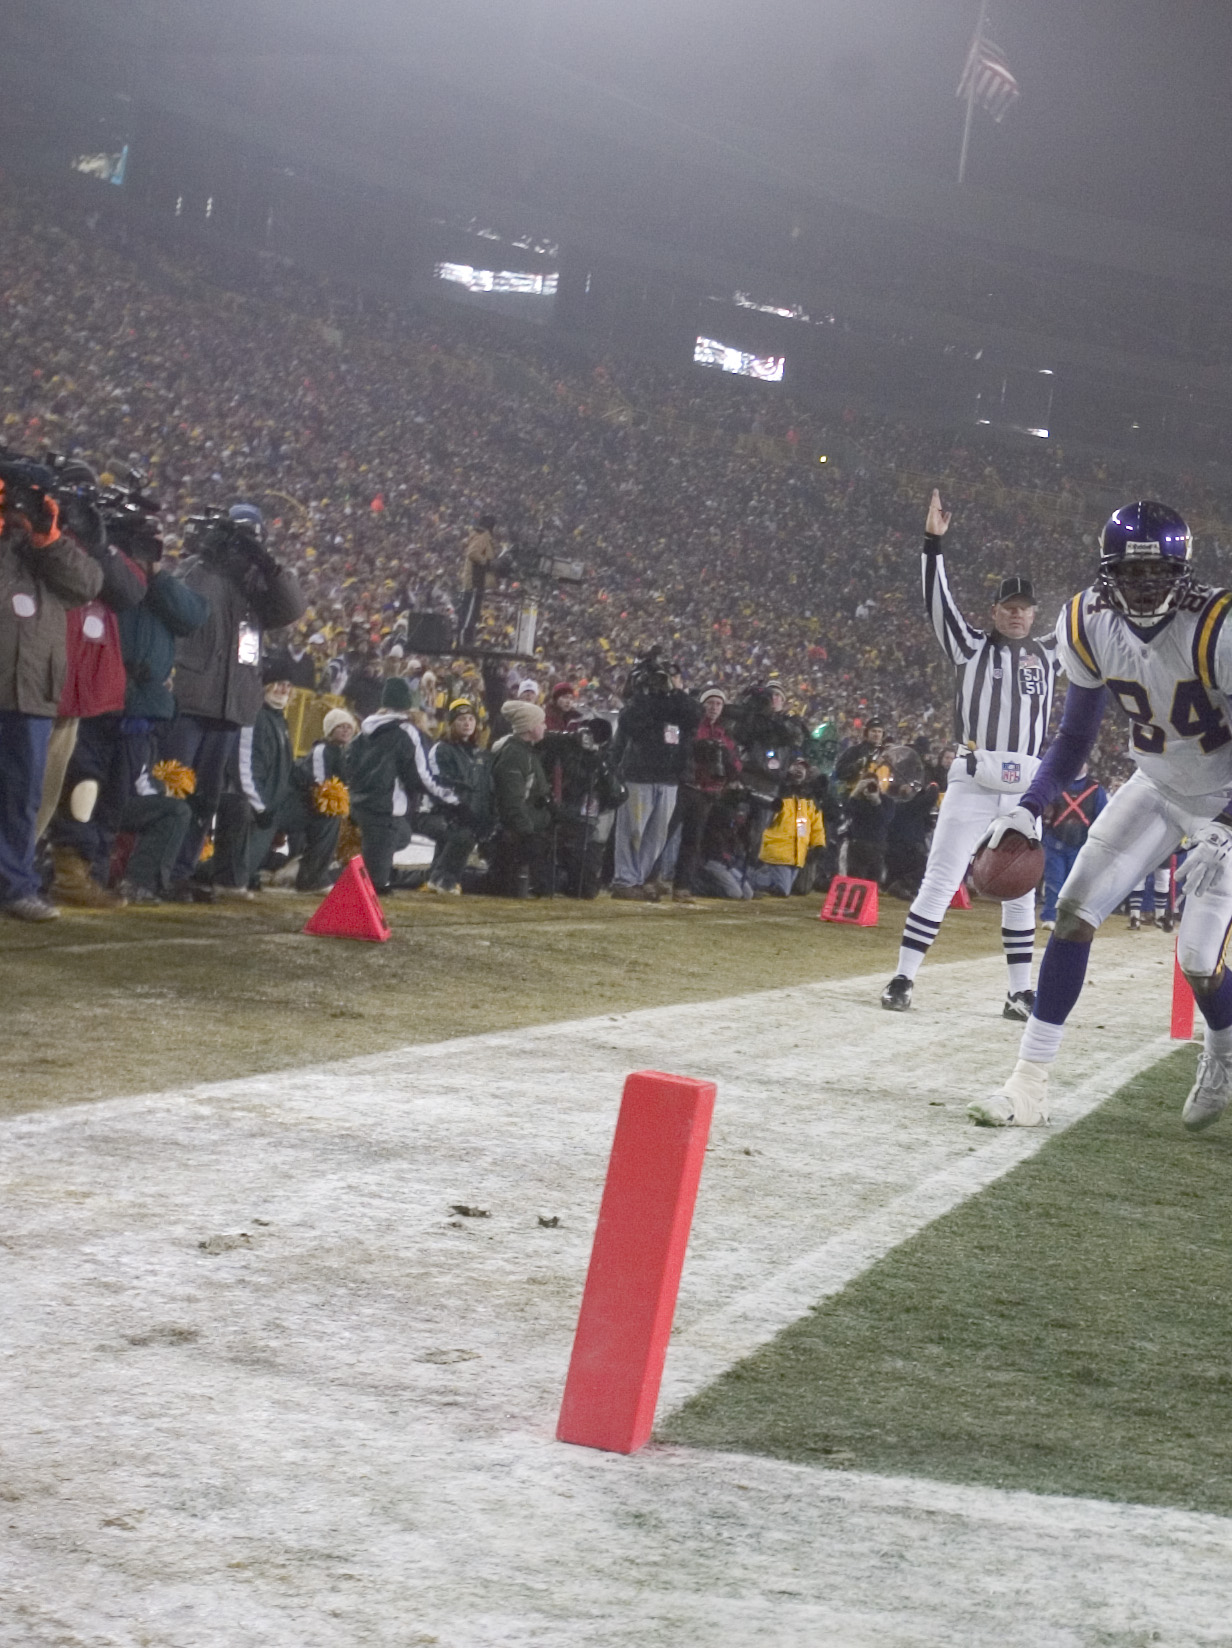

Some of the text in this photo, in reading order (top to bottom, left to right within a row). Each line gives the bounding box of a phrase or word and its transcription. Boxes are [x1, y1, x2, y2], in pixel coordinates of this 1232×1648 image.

[1023, 669, 1040, 681] SJ
[1026, 682, 1041, 695] 51
[1002, 769, 1019, 782] NFL
[832, 882, 868, 920] 10
